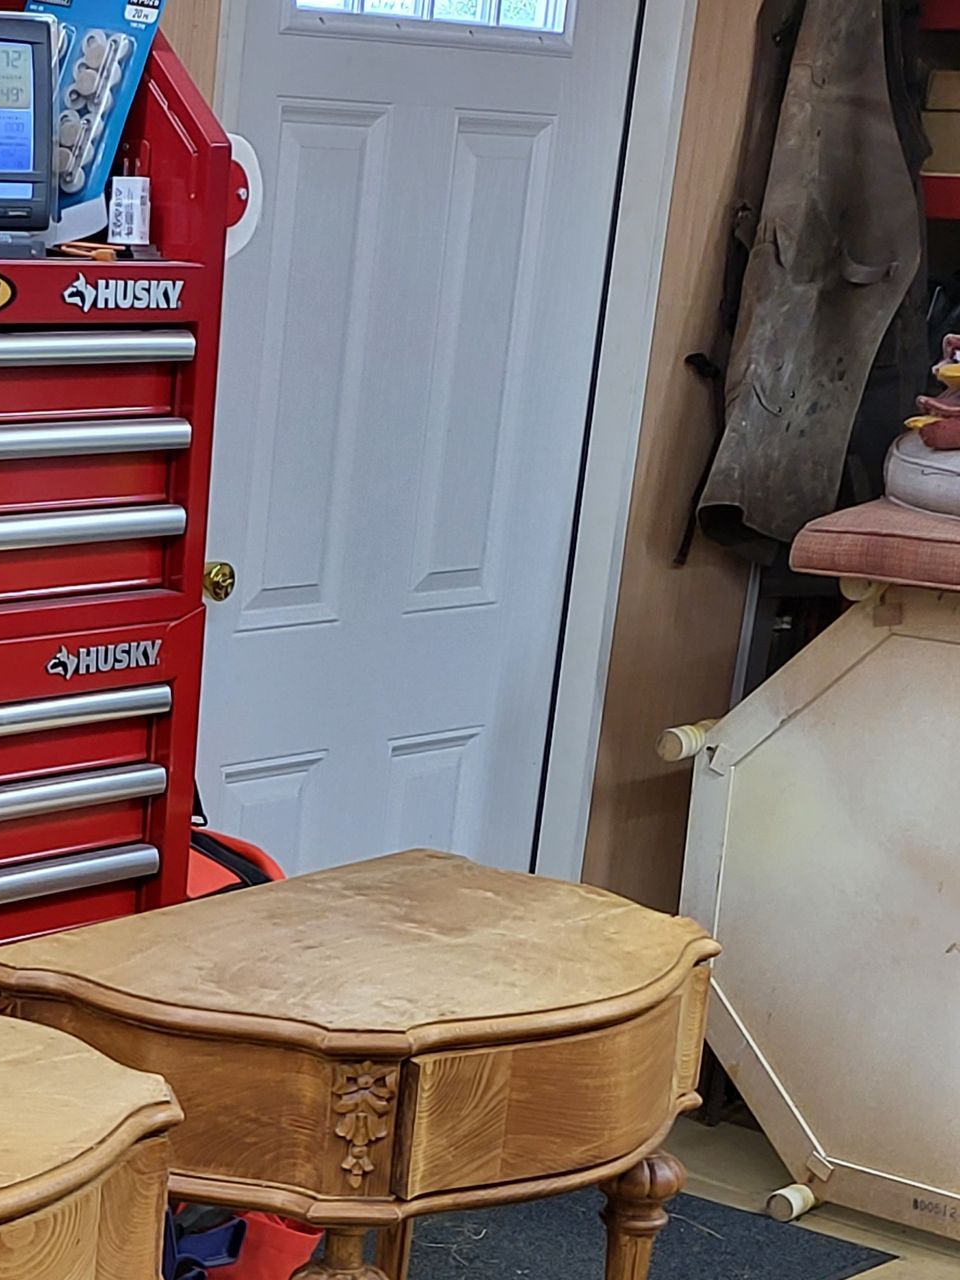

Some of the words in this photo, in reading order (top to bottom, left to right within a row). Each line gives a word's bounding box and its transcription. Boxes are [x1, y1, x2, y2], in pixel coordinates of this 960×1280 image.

[1, 49, 22, 69] 72
[97, 279, 185, 309] HUSKY
[79, 639, 162, 675] HUSKY
